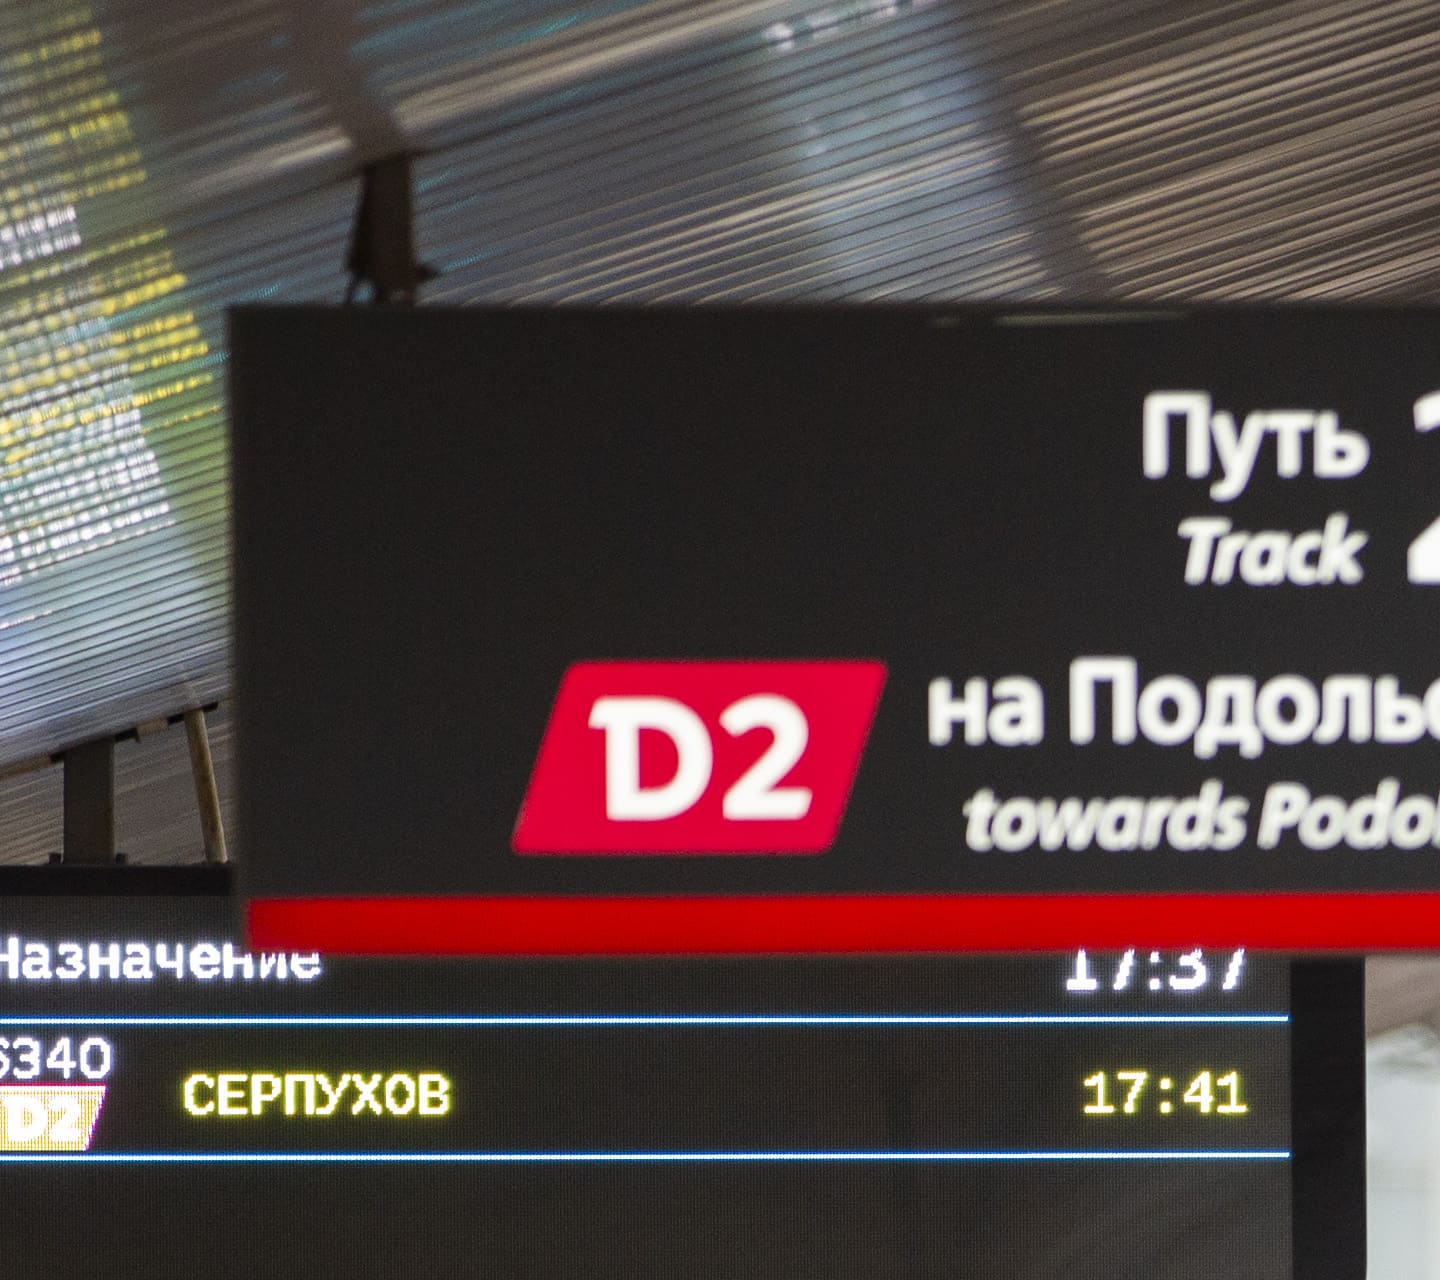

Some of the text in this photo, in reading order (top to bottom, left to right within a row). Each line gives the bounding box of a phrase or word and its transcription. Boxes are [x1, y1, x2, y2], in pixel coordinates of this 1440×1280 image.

[1142, 390, 1370, 502] Путь
[1177, 512, 1368, 587] Track
[927, 676, 1046, 747] на
[588, 692, 814, 823] D2
[963, 779, 1250, 851] towards
[5, 1096, 83, 1143] D2
[183, 1073, 453, 1117] СЕРПУХОВ
[1083, 1070, 1249, 1115] 17:41
